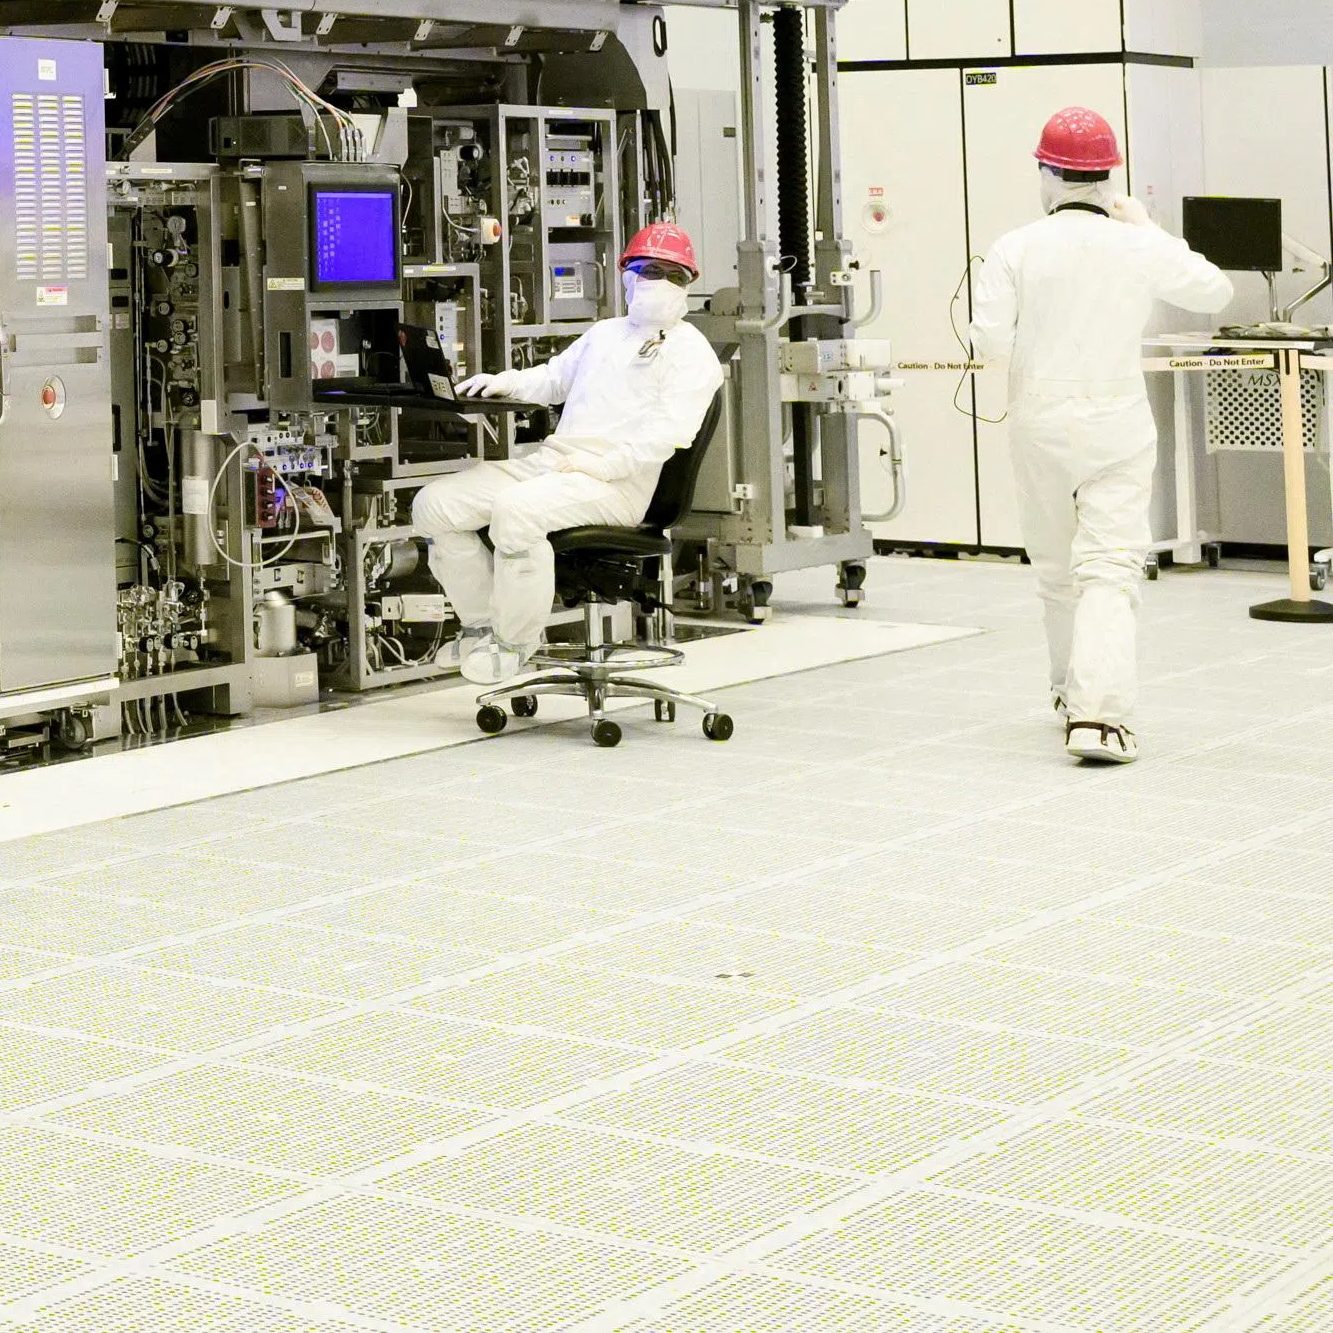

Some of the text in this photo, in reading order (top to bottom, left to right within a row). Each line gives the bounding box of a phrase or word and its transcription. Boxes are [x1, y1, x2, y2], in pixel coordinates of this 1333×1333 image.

[1223, 358, 1239, 366] Not
[1241, 357, 1265, 366] Enter
[898, 362, 928, 370] Caution
[934, 362, 946, 370] Do
